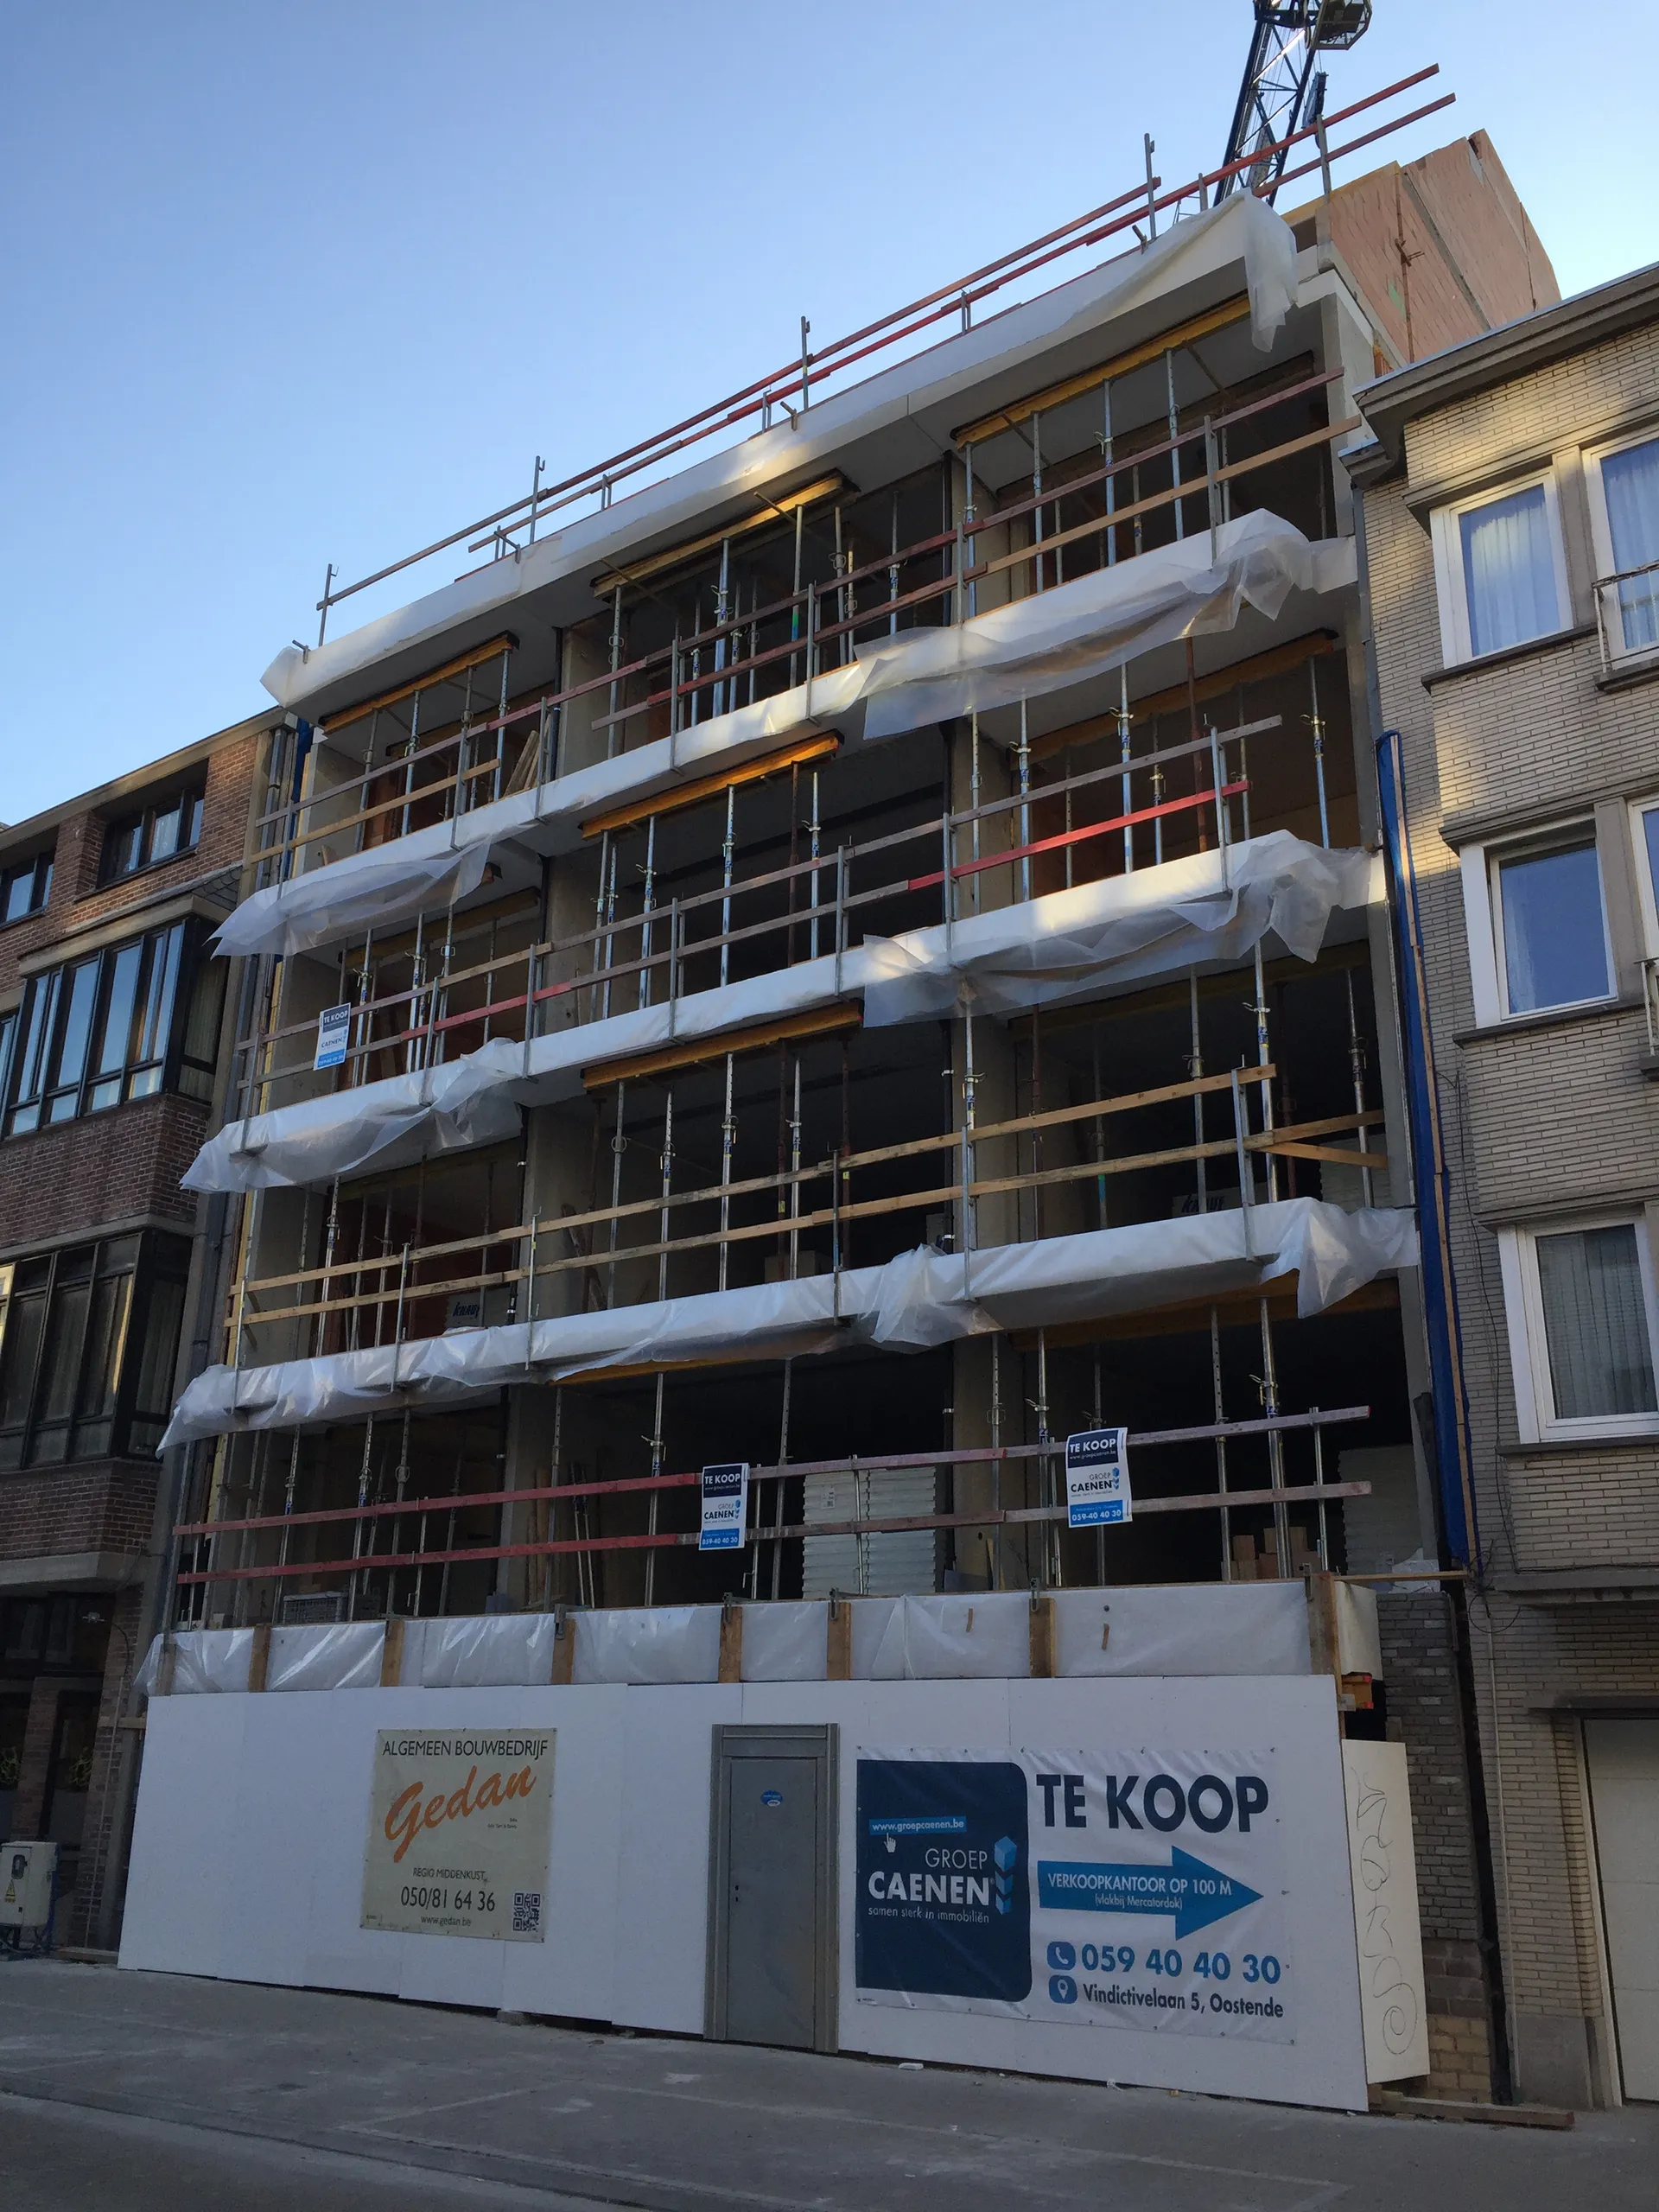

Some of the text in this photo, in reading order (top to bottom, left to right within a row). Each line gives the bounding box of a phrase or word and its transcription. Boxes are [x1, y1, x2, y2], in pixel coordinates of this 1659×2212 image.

[1070, 1438, 1116, 1453] TE KOOP
[704, 1473, 741, 1484] TE KOOP
[1089, 1471, 1111, 1481] GROEP
[1071, 1480, 1113, 1492] CAENEN
[704, 1510, 734, 1520] CAENEN
[1071, 1512, 1098, 1522] 059-40
[1111, 1509, 1122, 1517] 30
[383, 1739, 549, 1760] ALGEMEEN BOUWBEDRIJF
[1036, 1774, 1268, 1834] TE KOOP
[385, 1765, 537, 1863] Gedan
[872, 1818, 964, 1832] www.groepcaenen.be
[925, 1847, 988, 1870] GROEP
[413, 1867, 486, 1880] REGIO MIDDENKUST
[868, 1871, 990, 1906] CAENEN
[1047, 1873, 1232, 1896] VERKOOPKANTOOR OP 100 M
[401, 1886, 496, 1912] 050/81 64 36
[1095, 1893, 1183, 1911] (vlakbij Mercatordok)
[421, 1915, 472, 1927] www.gedan.be
[868, 1906, 989, 1923] samen sterk in immobiliën
[1082, 1944, 1281, 1985] 059 40 40 30
[1083, 1983, 1284, 2018] Vindictivelaan 5, Oostende
